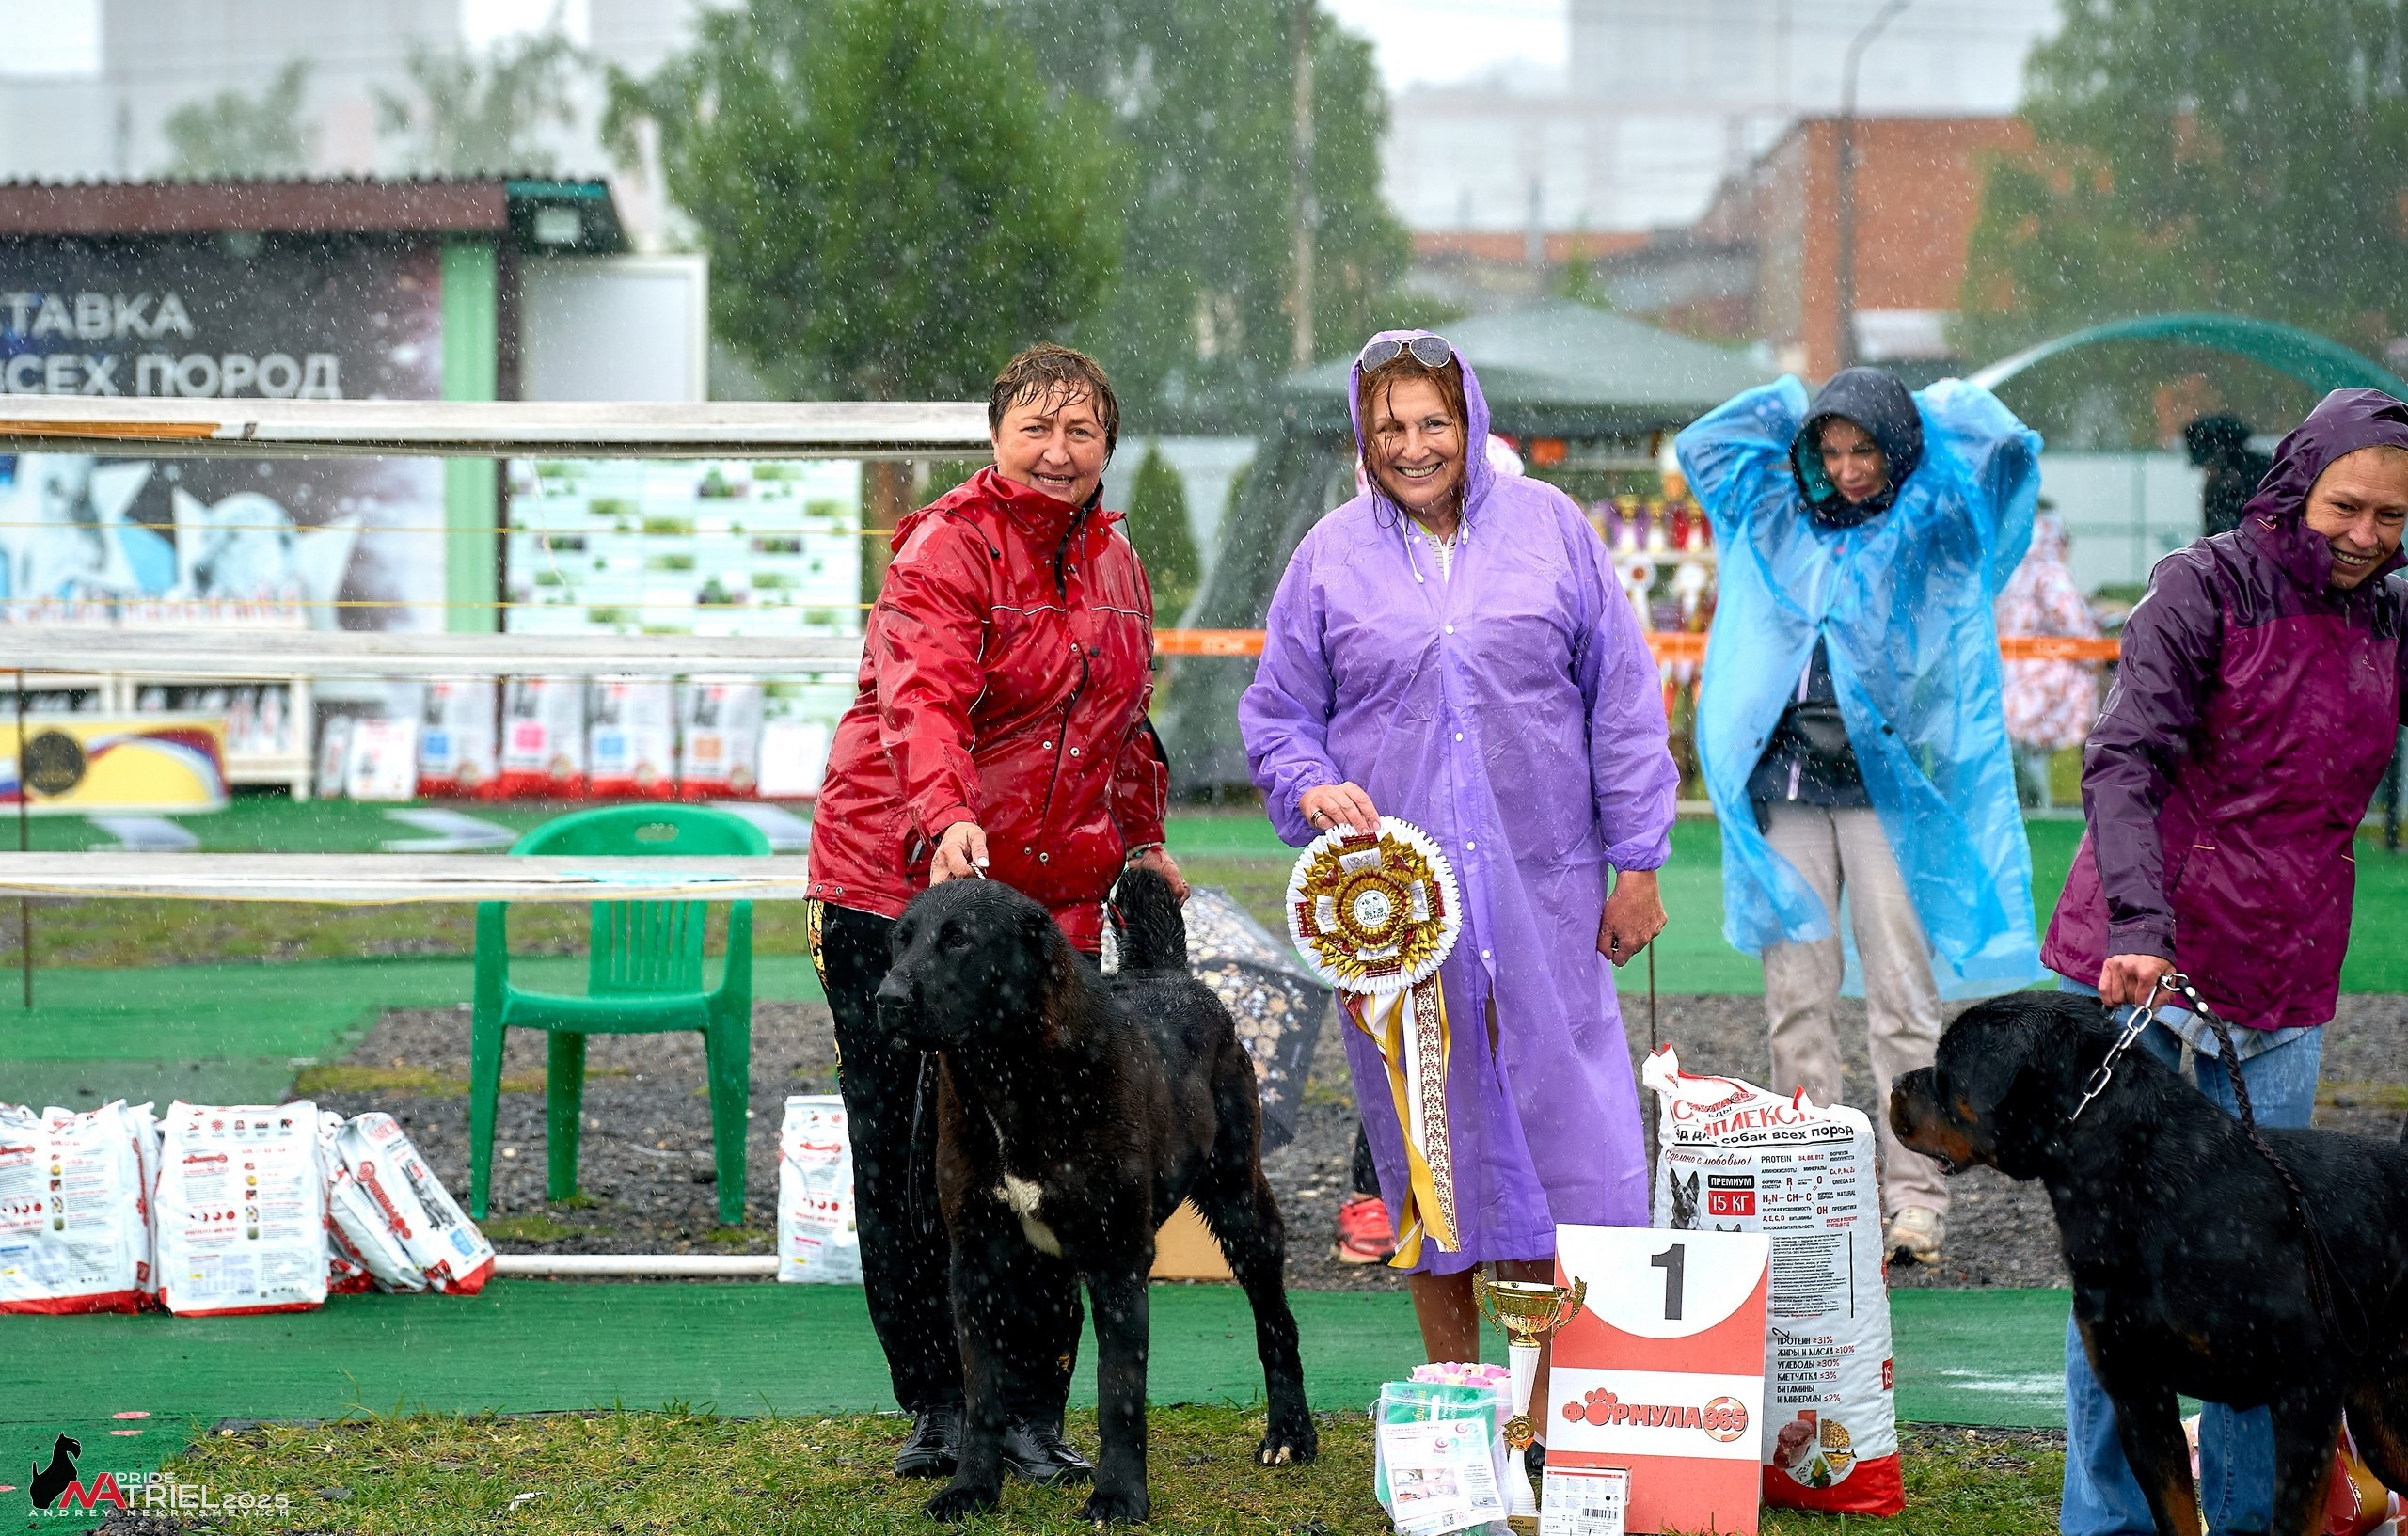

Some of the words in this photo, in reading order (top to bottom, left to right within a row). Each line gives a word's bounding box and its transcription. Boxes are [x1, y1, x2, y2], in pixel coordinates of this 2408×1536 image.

[0, 353, 119, 395] СЕХ
[135, 352, 344, 399] ПОРОД
[1721, 1132, 1767, 1144] собак
[1772, 1131, 1807, 1140] всех
[1812, 1126, 1853, 1138] пород
[1665, 1149, 1695, 1164] Сделано
[1713, 1196, 1727, 1211] 15
[1733, 1196, 1749, 1211] КГ
[1817, 1206, 1828, 1214] OH
[1651, 1243, 1685, 1320] 1
[1778, 1385, 1814, 1393] ВИТАМИНЫ
[1784, 1395, 1821, 1403] МИНЕРАЛЫ
